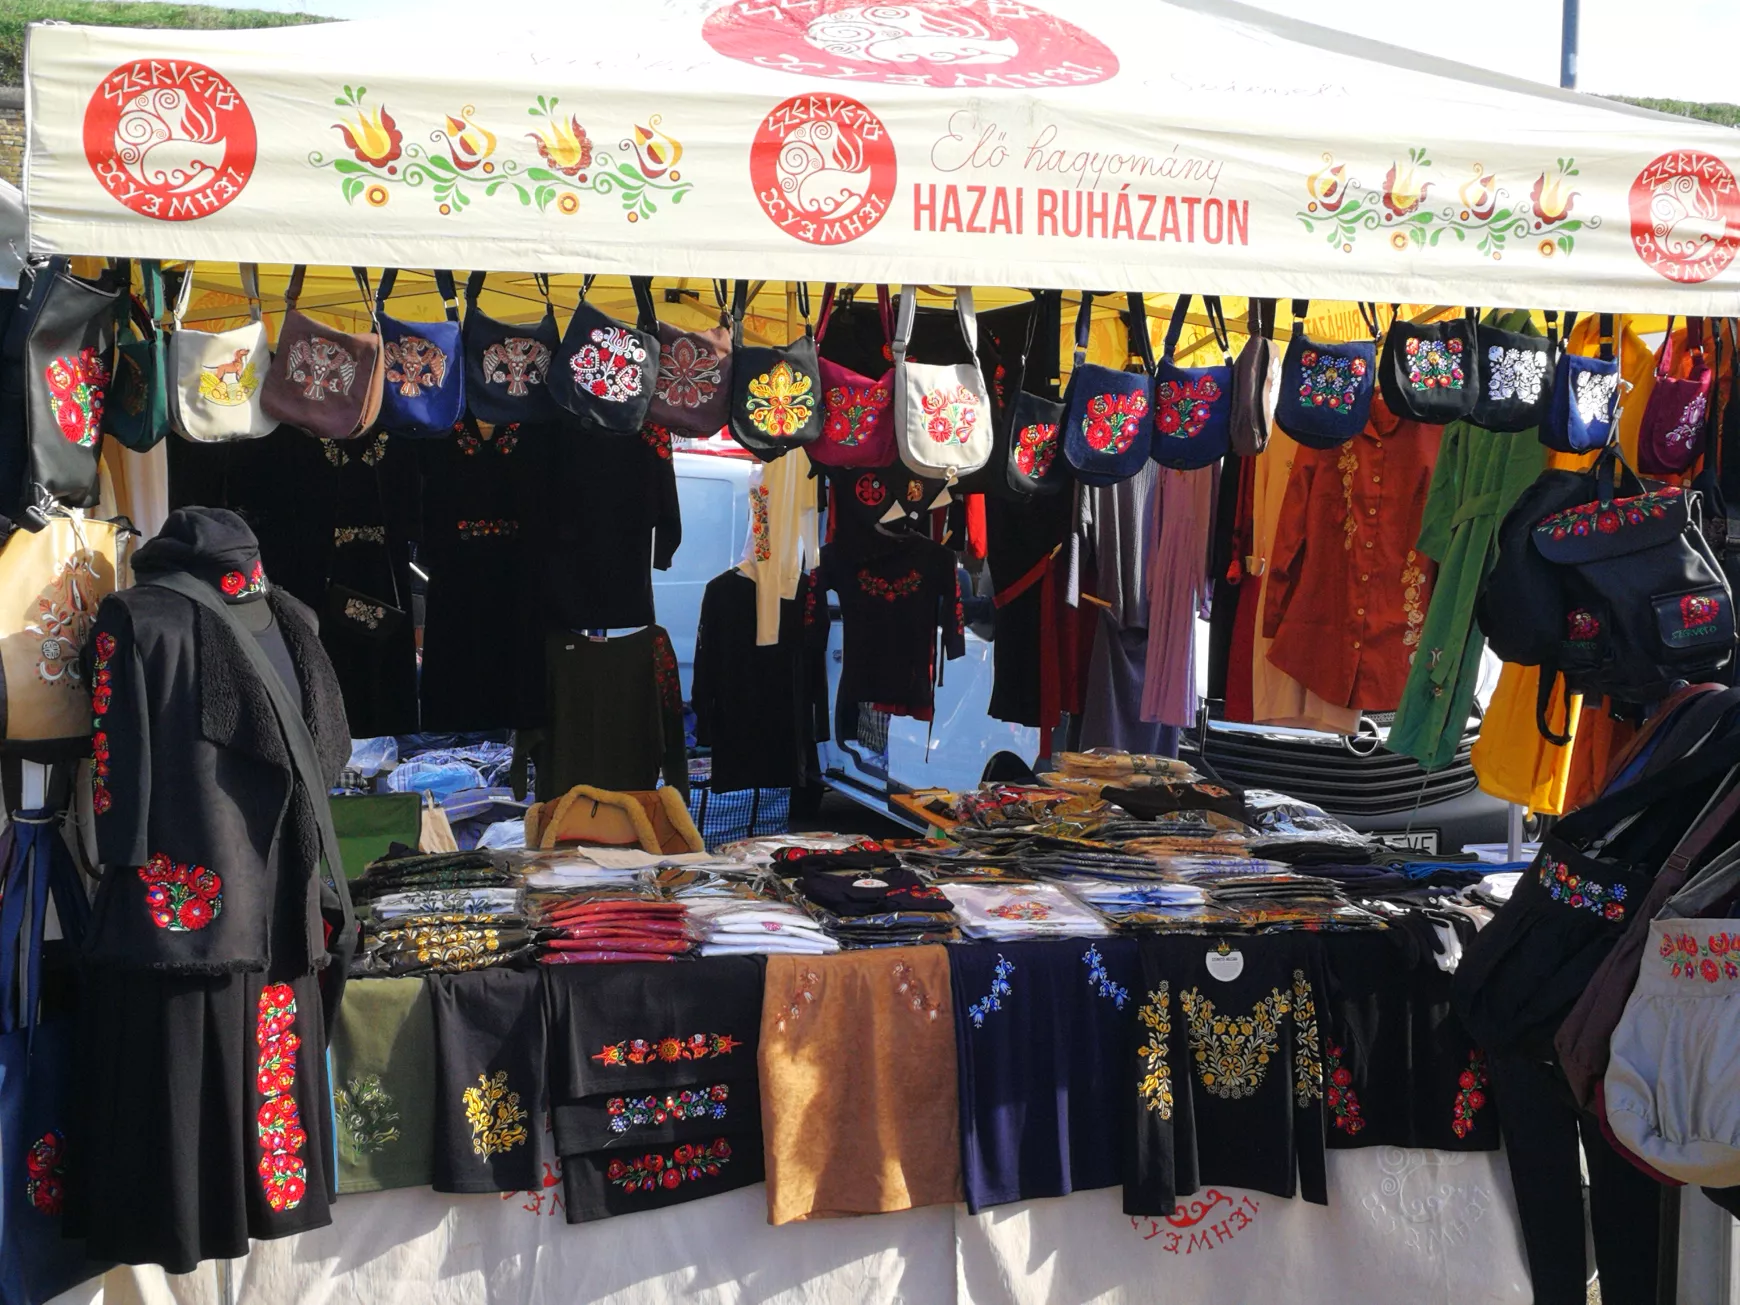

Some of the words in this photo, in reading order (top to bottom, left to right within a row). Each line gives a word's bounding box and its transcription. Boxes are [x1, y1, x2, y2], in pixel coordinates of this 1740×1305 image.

[1024, 123, 1224, 195] hagyomány
[913, 183, 1024, 235] HAZAI
[1037, 182, 1251, 246] RUHÁZATON
